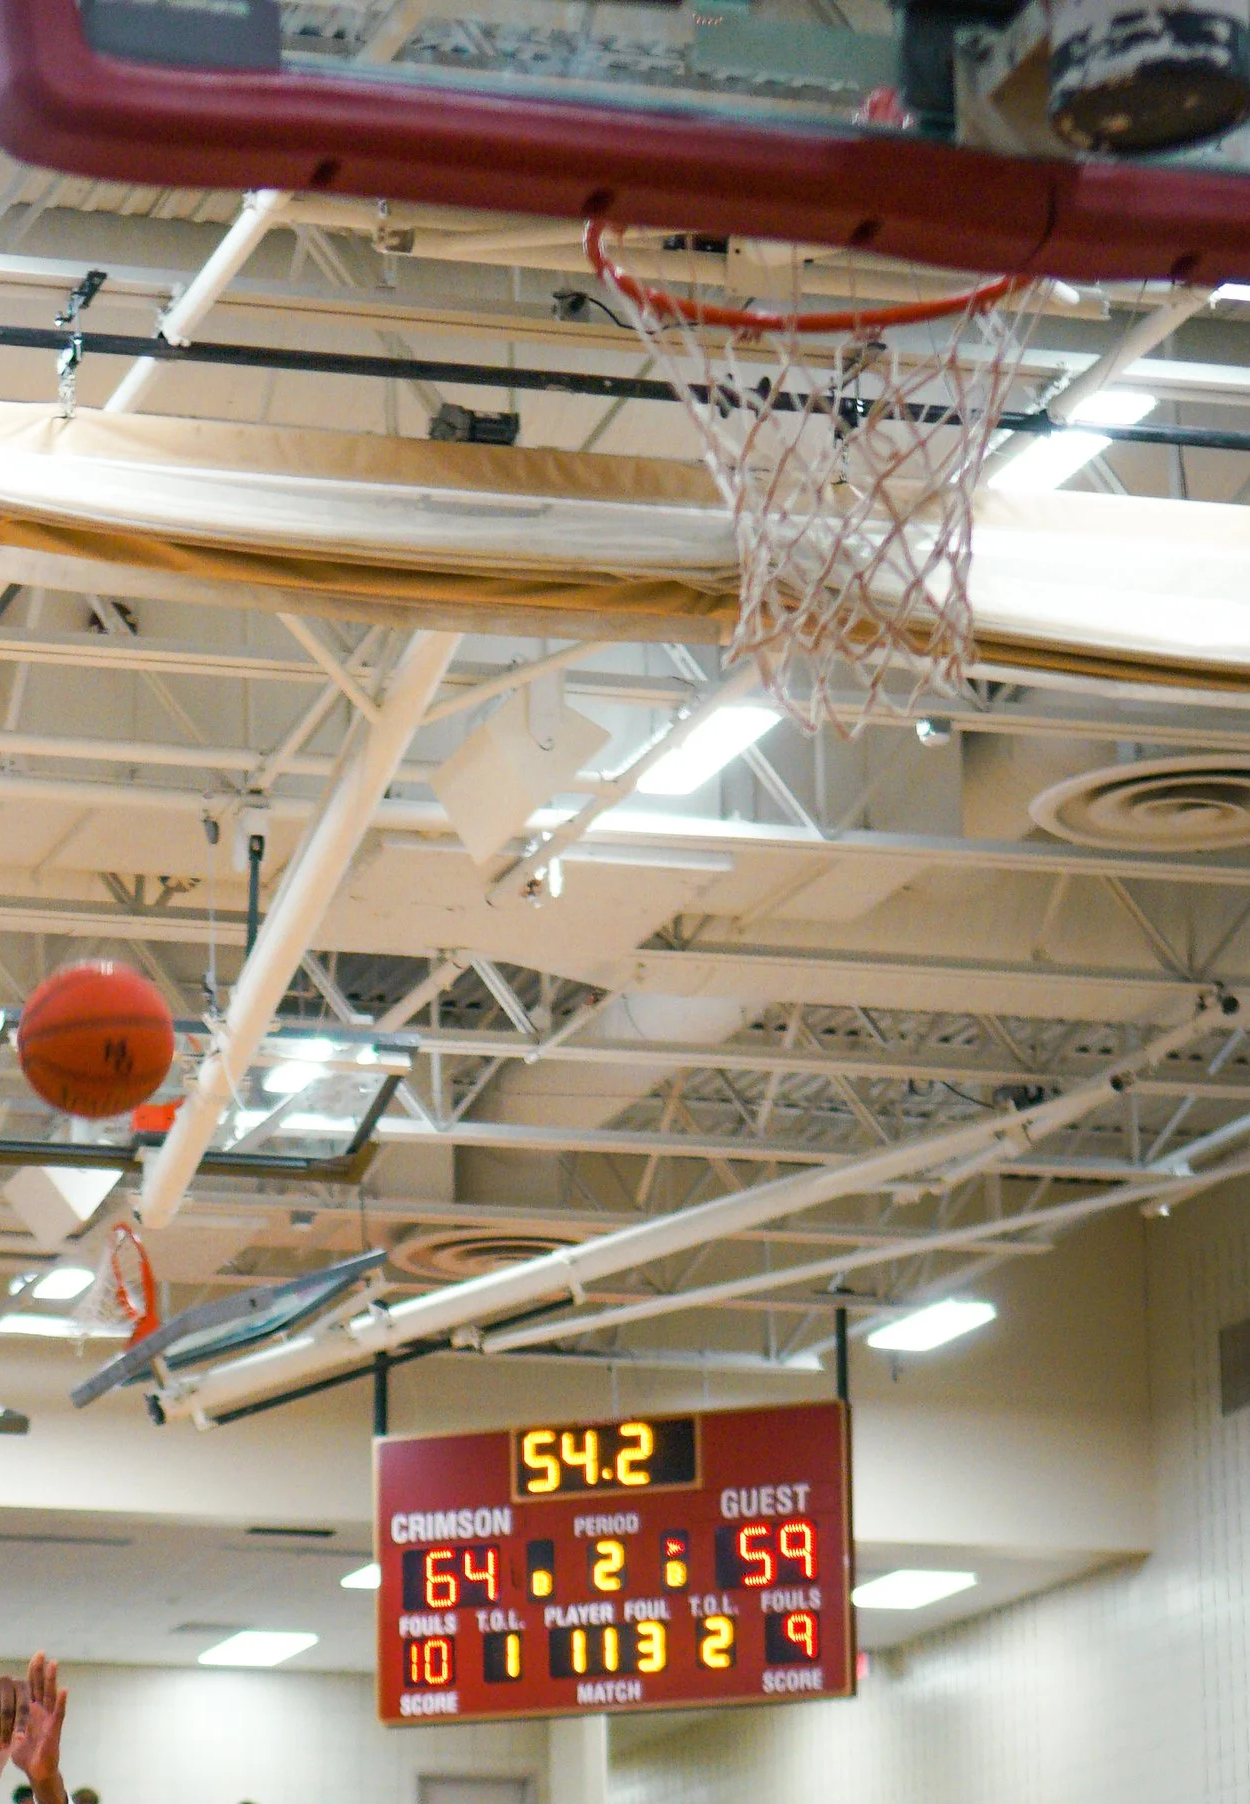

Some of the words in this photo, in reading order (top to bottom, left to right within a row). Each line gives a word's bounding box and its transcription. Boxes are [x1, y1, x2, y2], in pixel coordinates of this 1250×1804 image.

[523, 1422, 654, 1493] 54.2
[720, 1482, 811, 1520] GUEST
[390, 1506, 513, 1545] CRIMSON
[573, 1511, 640, 1538] PERIOD
[593, 1540, 626, 1592] 2
[737, 1520, 818, 1590] 59
[424, 1547, 500, 1609] 64
[544, 1601, 614, 1629] PLAYER
[623, 1598, 671, 1623] FOUL
[760, 1587, 823, 1613] FOULS
[398, 1611, 458, 1638] FOULS
[701, 1614, 735, 1669] 2
[784, 1610, 818, 1660] 9
[409, 1635, 452, 1686] 10
[505, 1632, 521, 1679] 1
[576, 1679, 644, 1706] MATCH
[761, 1667, 825, 1694] SCORE
[399, 1691, 459, 1717] SCORE
